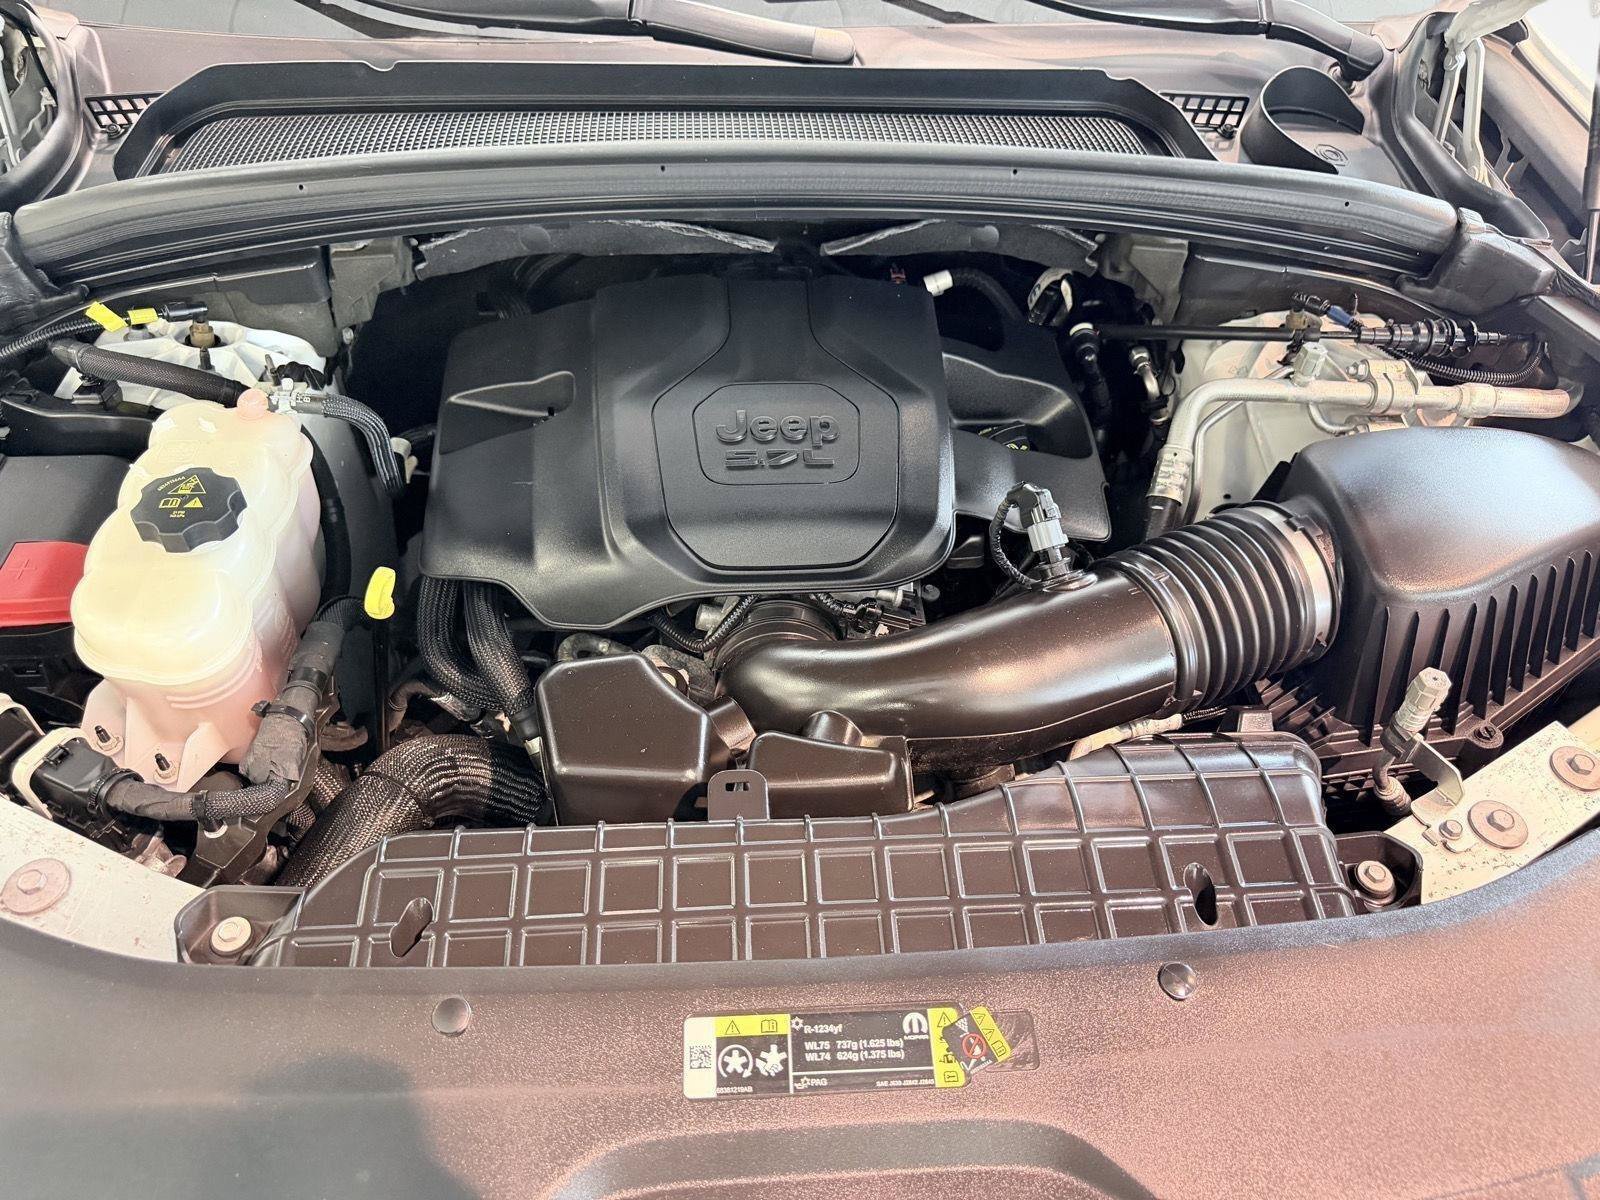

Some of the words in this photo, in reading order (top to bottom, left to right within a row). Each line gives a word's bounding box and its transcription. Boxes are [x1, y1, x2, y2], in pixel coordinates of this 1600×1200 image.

[715, 409, 840, 448] Jeep
[803, 1023, 843, 1035] R-1234yf
[804, 1041, 831, 1051] WL75
[836, 1040, 858, 1050] 737g
[859, 1039, 886, 1050] (1.625
[886, 1038, 904, 1049] lbs)
[805, 1052, 831, 1062] WL74
[836, 1051, 859, 1061] 624g
[860, 1050, 887, 1060] (1.375
[887, 1049, 905, 1060] lbs)
[810, 1078, 828, 1087] PAG
